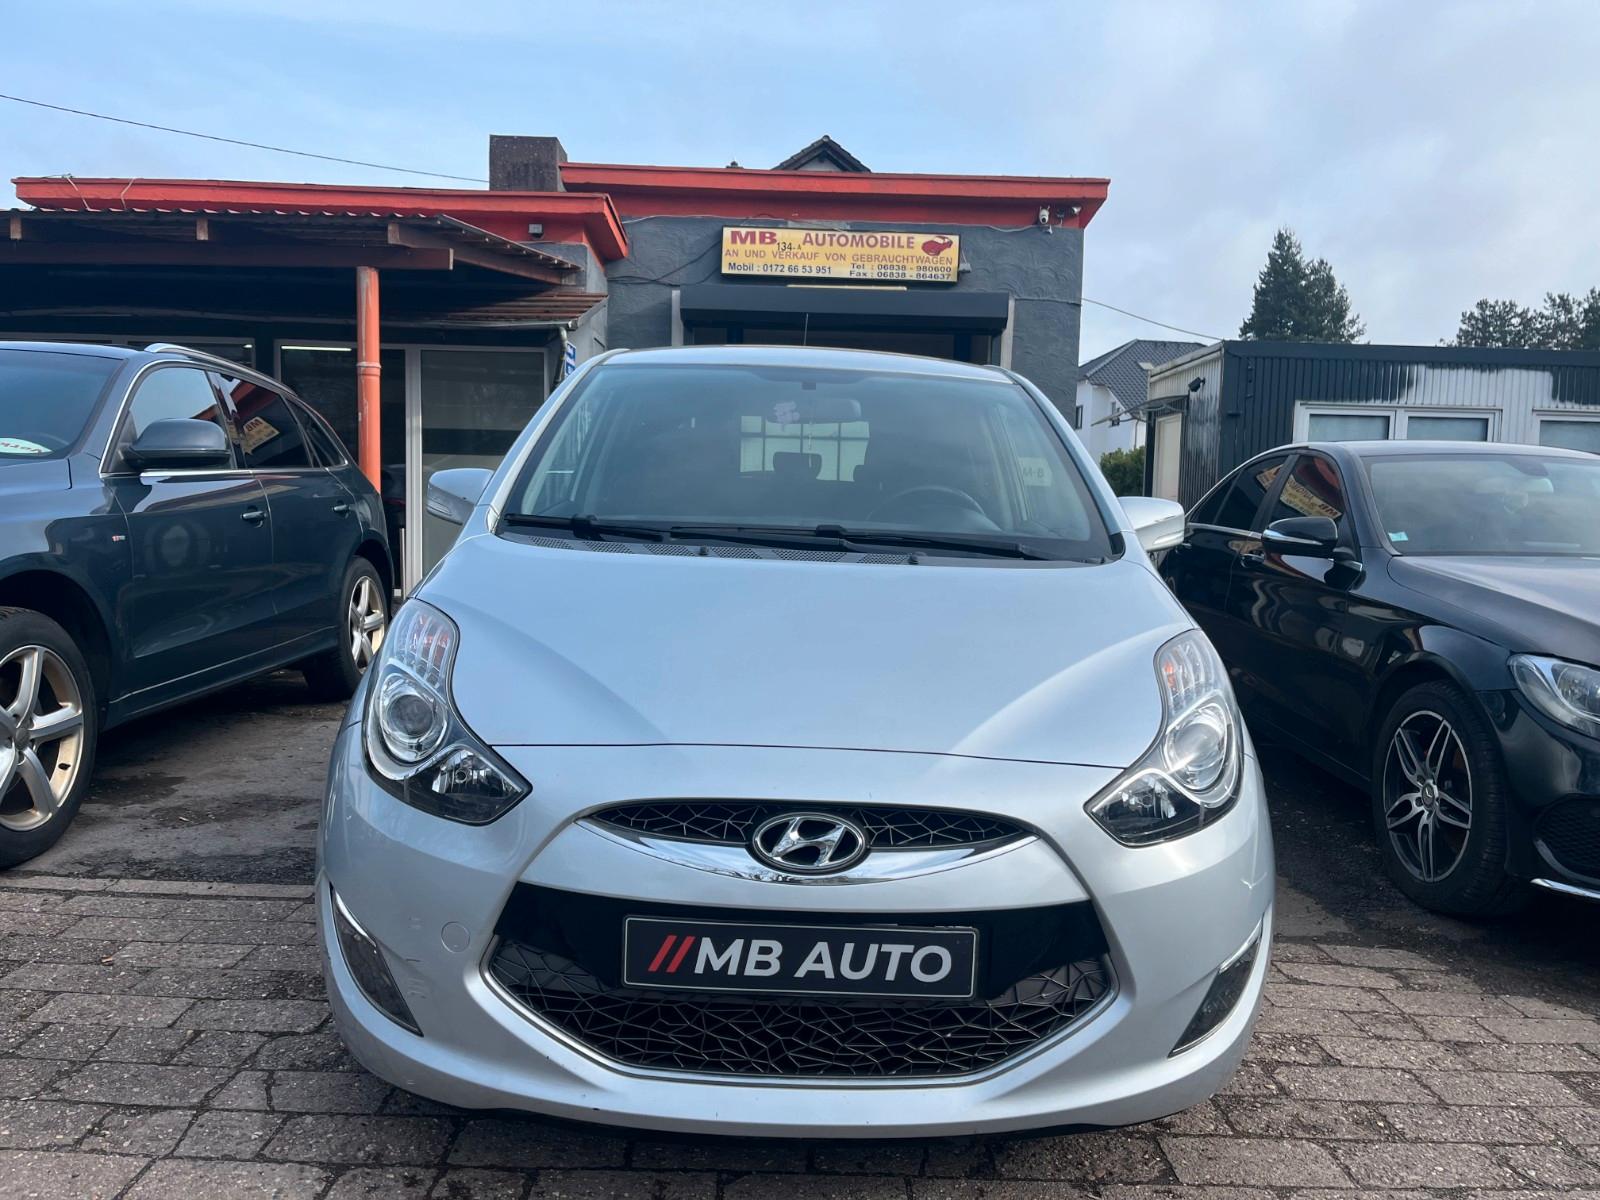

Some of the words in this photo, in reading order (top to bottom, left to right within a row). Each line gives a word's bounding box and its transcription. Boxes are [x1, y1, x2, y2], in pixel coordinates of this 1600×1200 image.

[731, 231, 777, 244] MB
[802, 233, 915, 249] AUTOMOBILE
[725, 249, 739, 257] AN
[745, 250, 766, 258] UND
[772, 251, 820, 260] VERKAUF
[825, 252, 846, 261] VON
[851, 254, 953, 265] GEBRAUCHTWAGEN
[728, 262, 754, 271] Mobil
[762, 264, 785, 272] 0172
[788, 265, 799, 273] 66
[802, 265, 812, 274] 53
[815, 266, 832, 274] 951
[793, 941, 952, 984] AUTO
